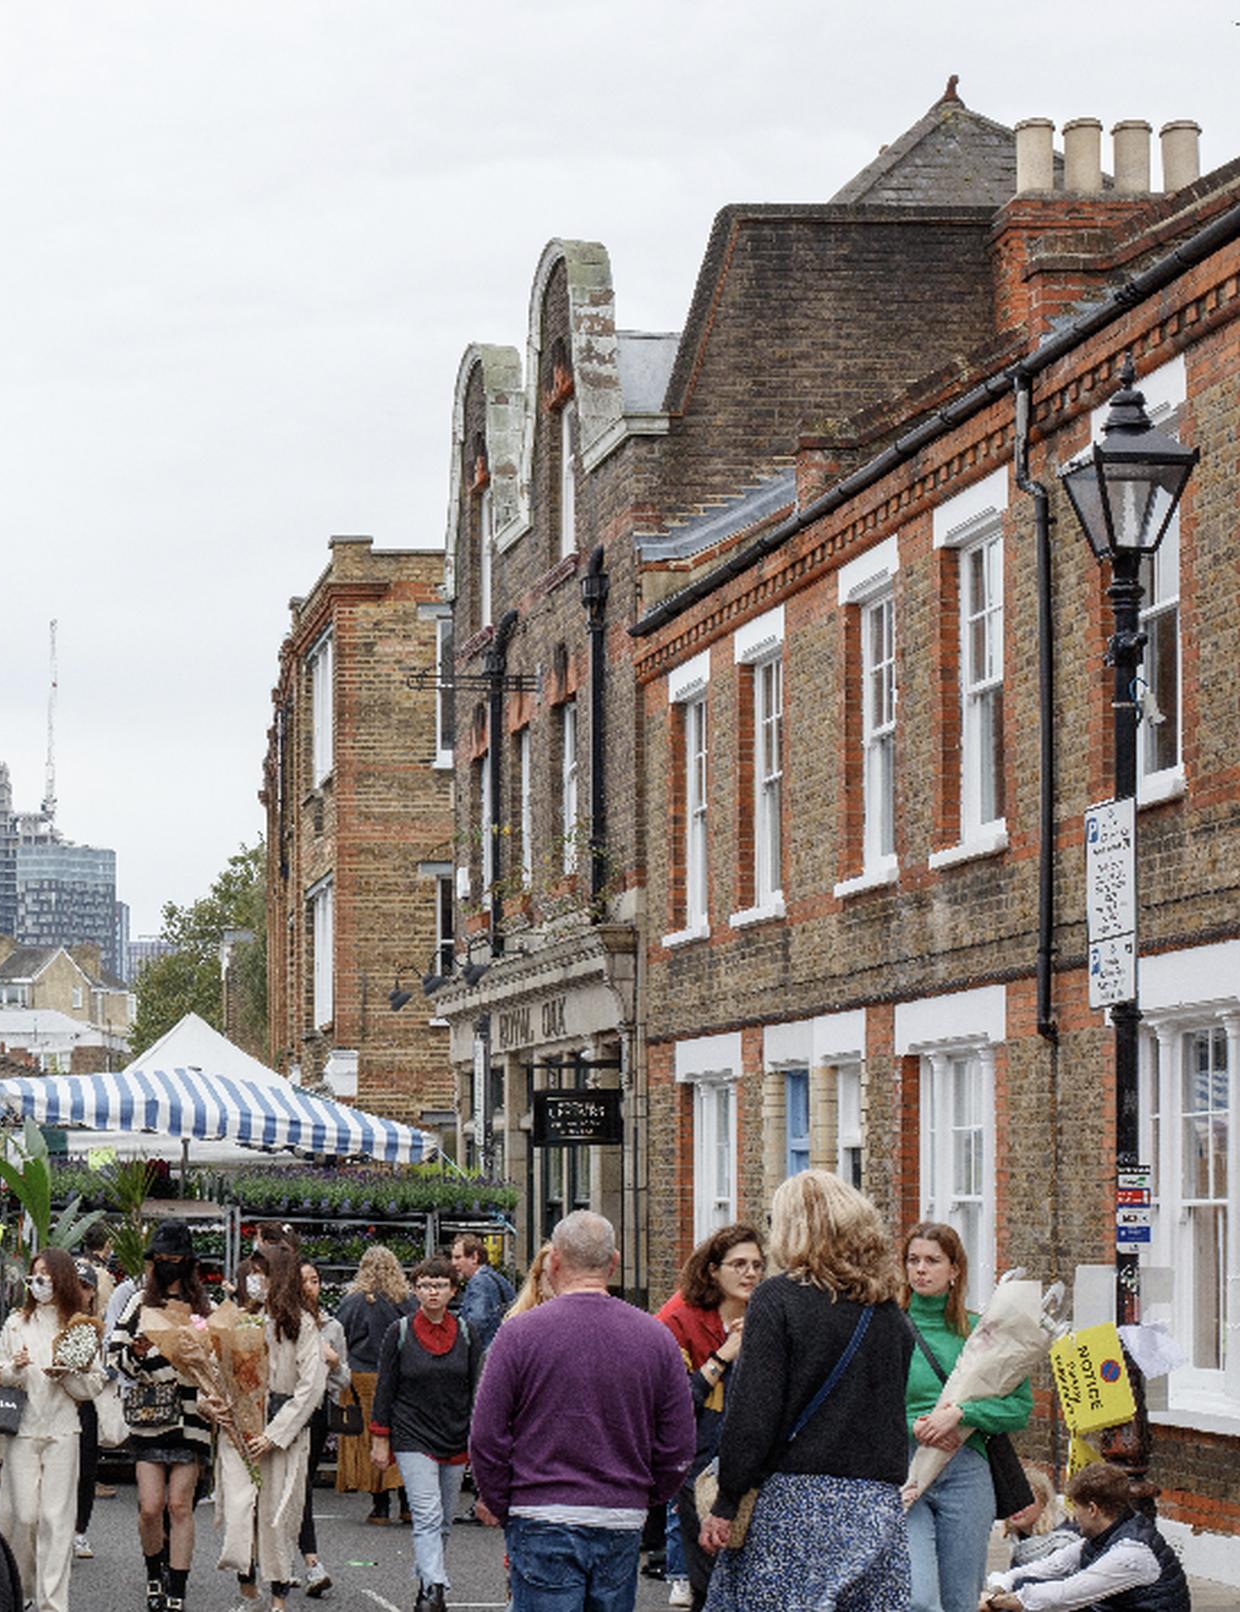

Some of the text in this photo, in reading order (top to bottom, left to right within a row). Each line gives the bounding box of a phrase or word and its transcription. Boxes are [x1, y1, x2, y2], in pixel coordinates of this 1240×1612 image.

[499, 996, 567, 1049] ROYAL OAK
[1077, 1345, 1104, 1411] NOTICE
